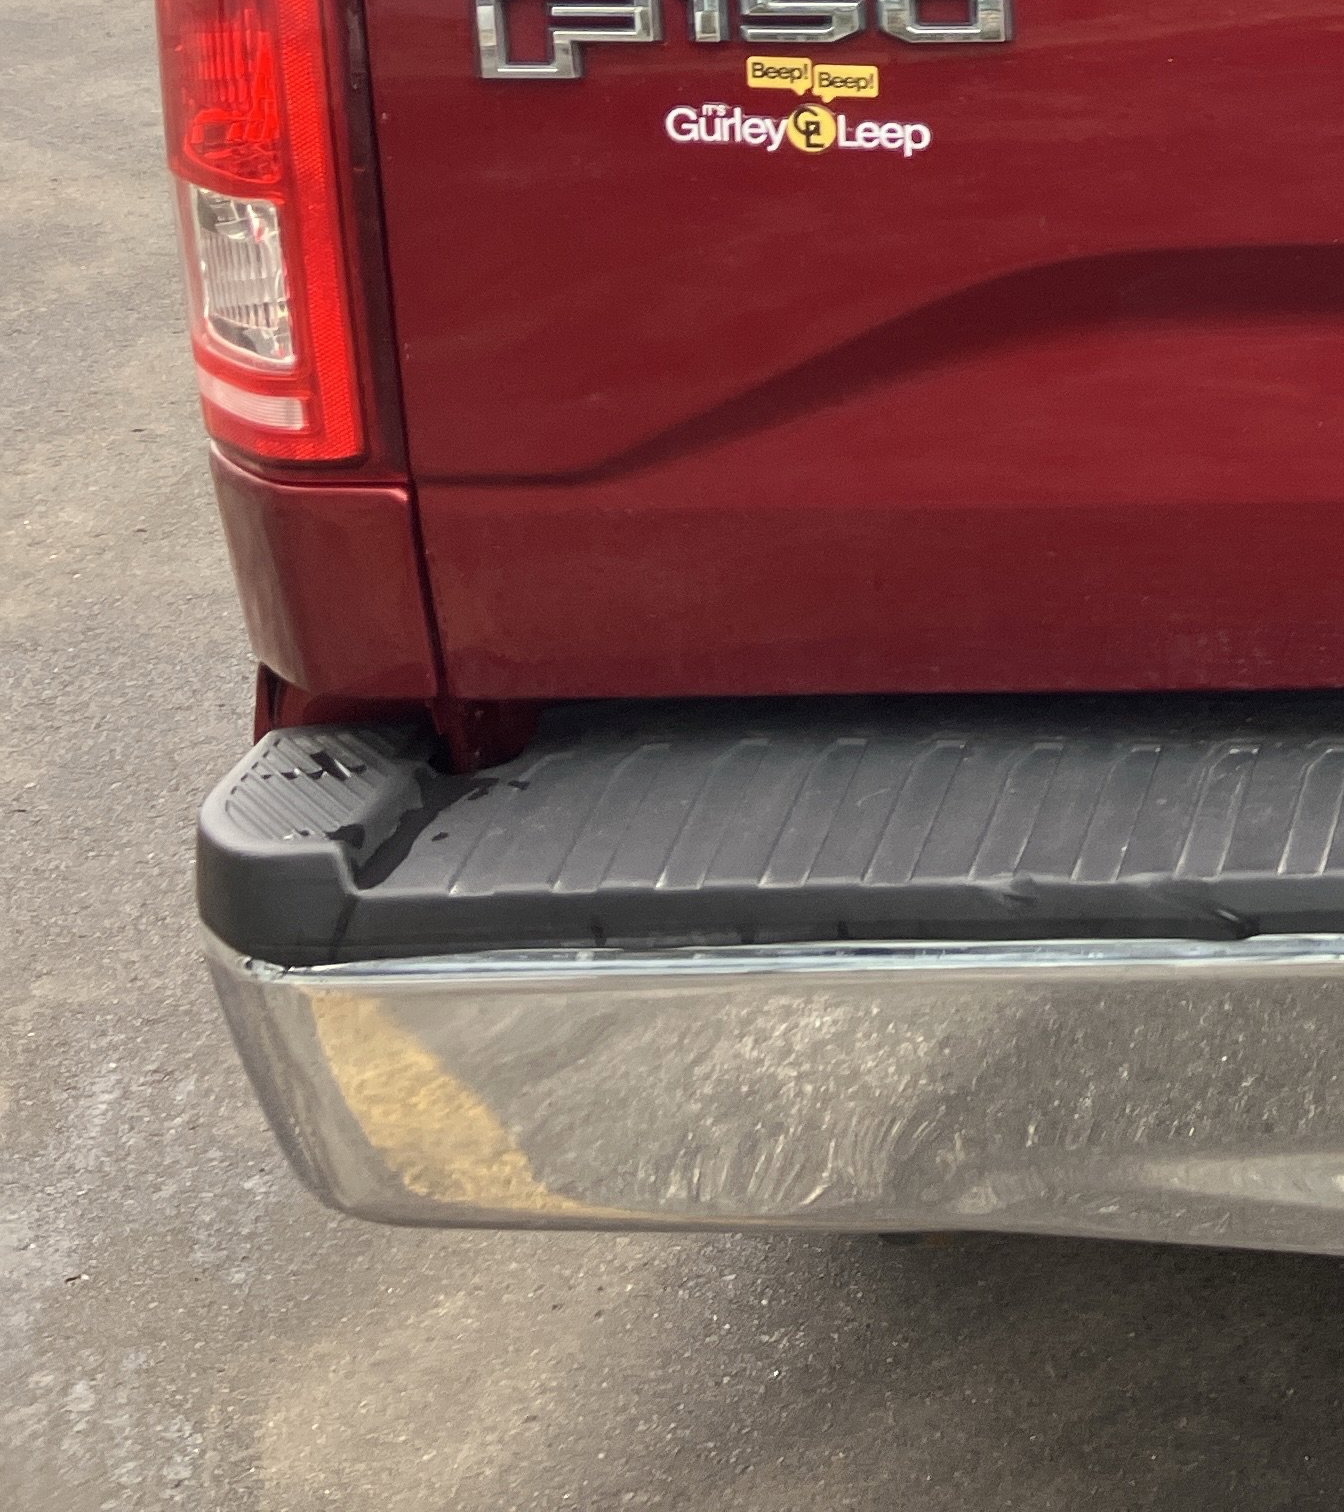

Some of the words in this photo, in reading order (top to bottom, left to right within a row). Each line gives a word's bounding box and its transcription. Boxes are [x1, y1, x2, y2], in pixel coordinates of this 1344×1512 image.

[750, 61, 810, 84] Beep!
[817, 71, 876, 91] Beep!
[664, 106, 788, 152] Gurley
[836, 114, 932, 157] Leep
